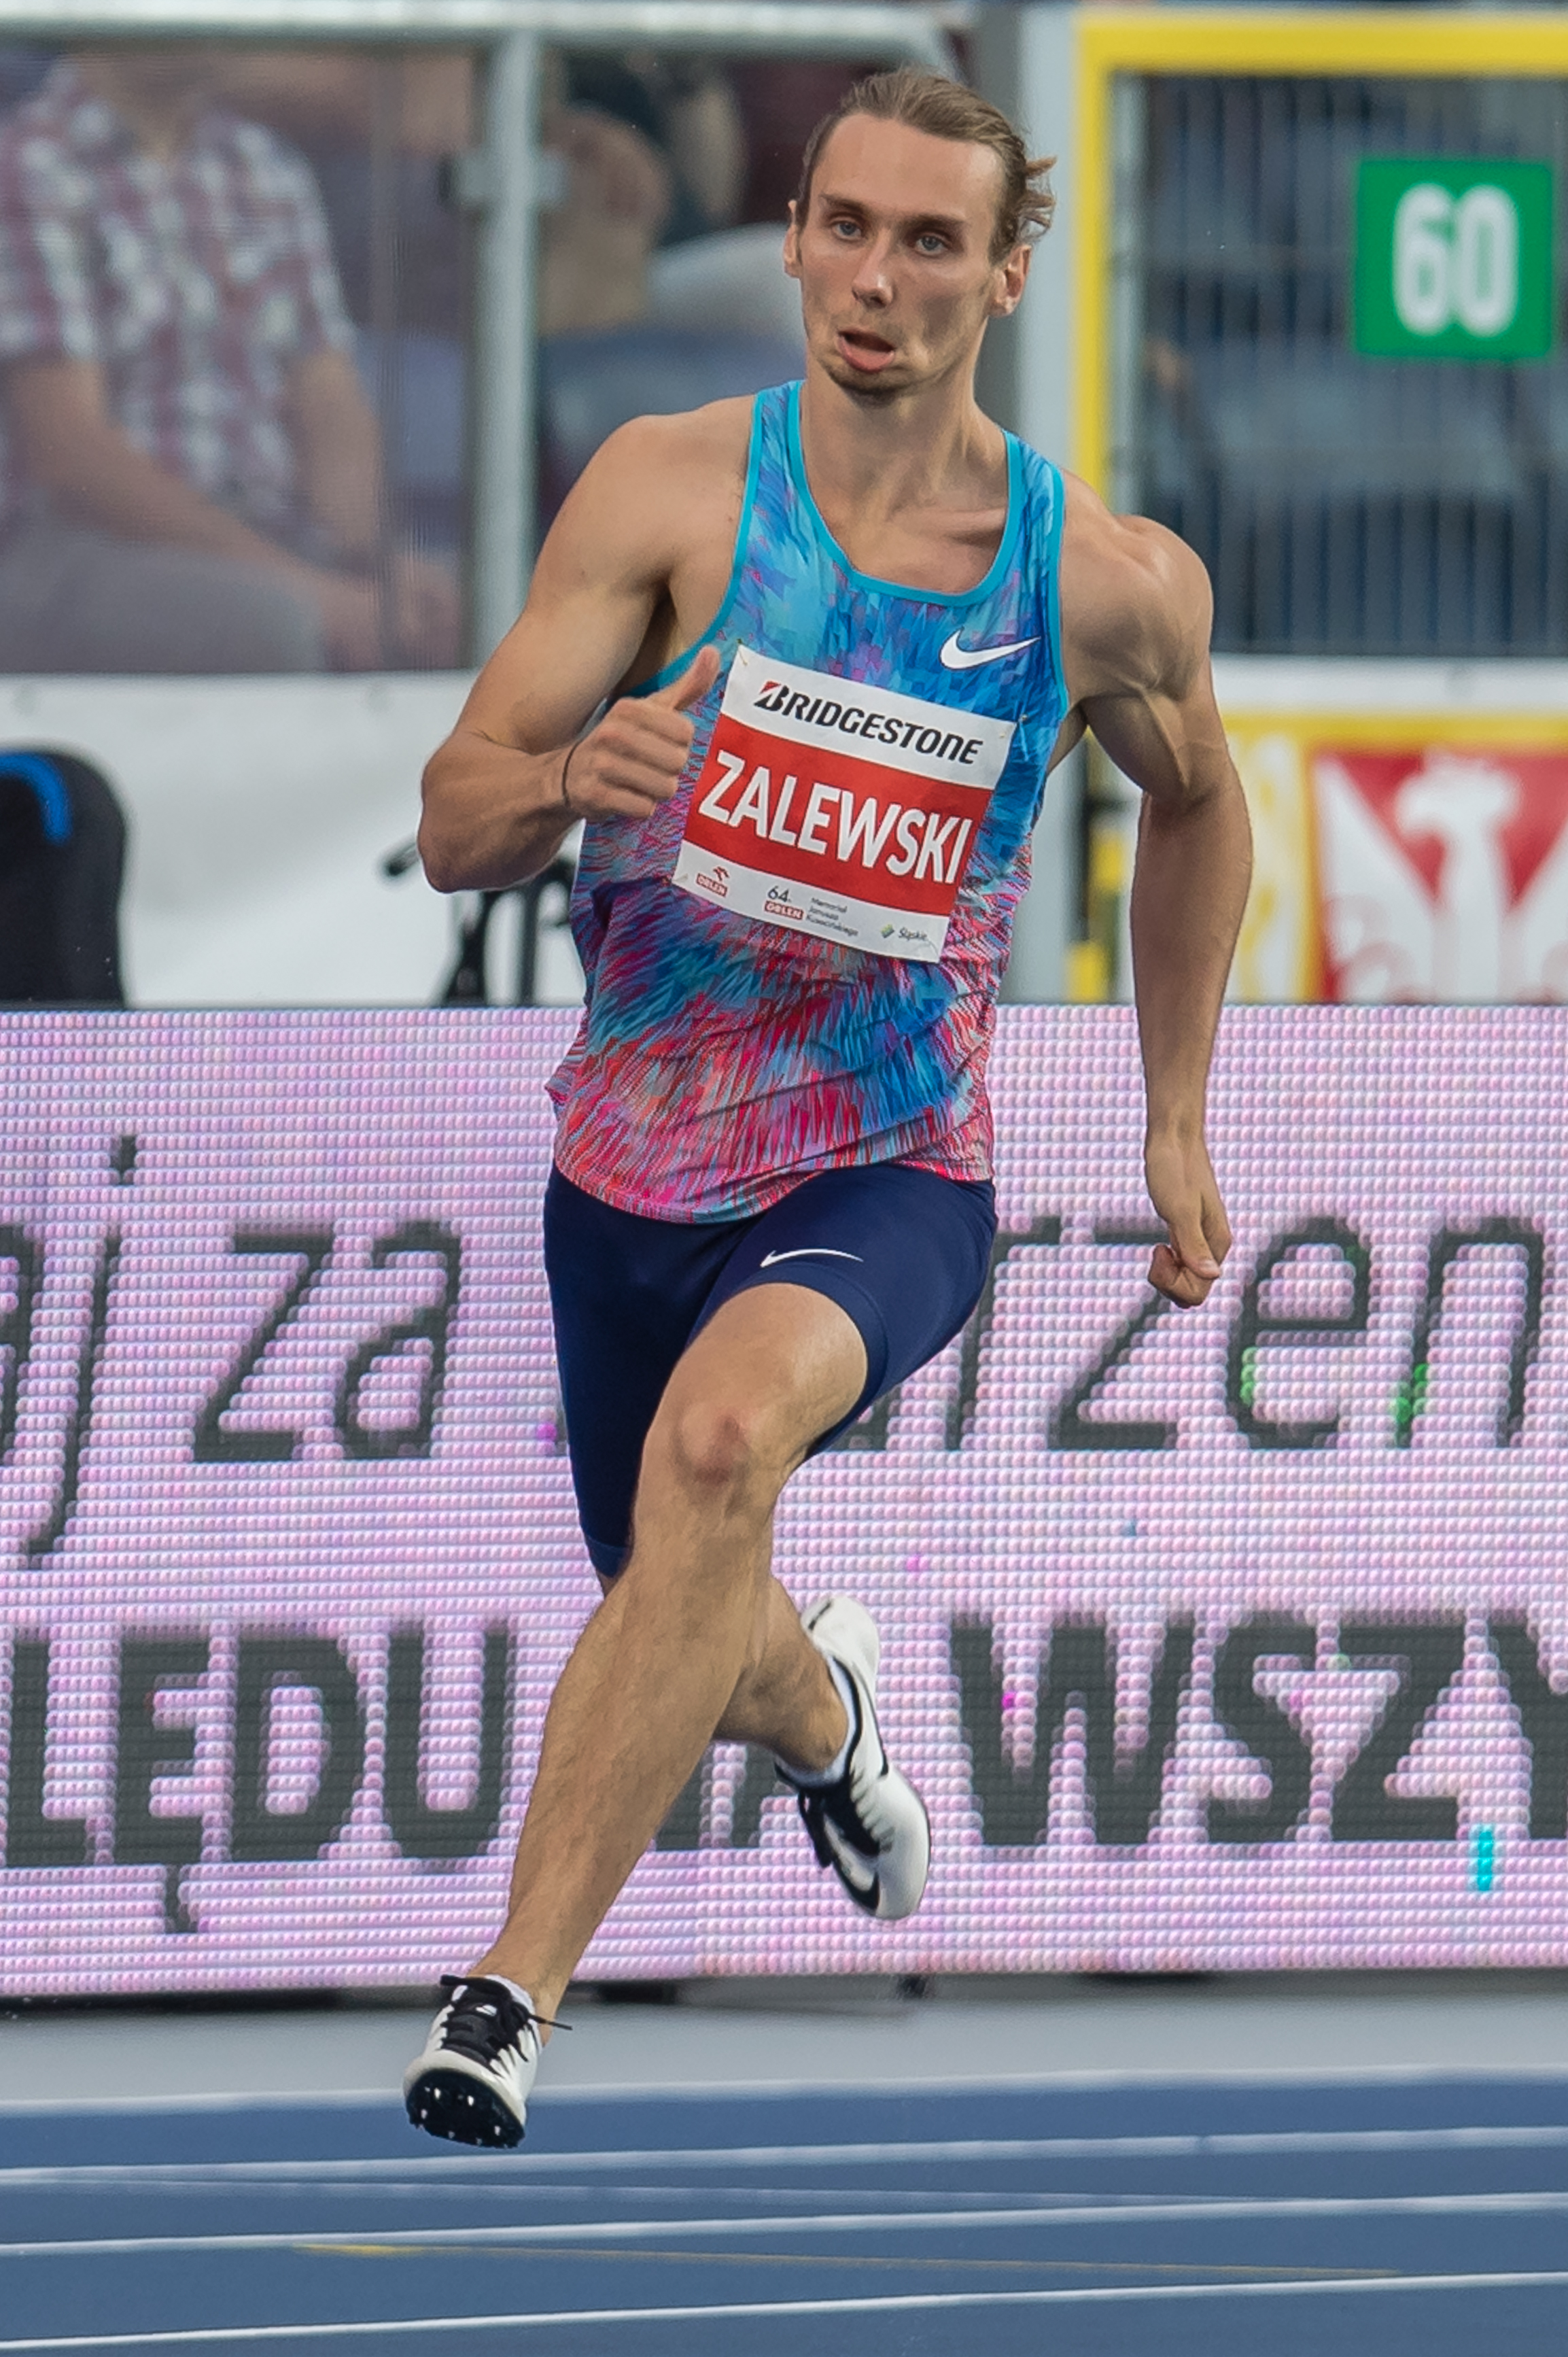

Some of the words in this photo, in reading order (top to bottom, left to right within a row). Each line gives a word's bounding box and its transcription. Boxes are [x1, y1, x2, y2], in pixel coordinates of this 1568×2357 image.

[1392, 182, 1520, 339] 60
[753, 681, 983, 765] BRIDGESTONE
[698, 749, 973, 884] ZALEWSKI
[765, 901, 804, 920] ORLEN
[193, 1218, 464, 1463] za
[557, 1214, 1544, 1451] rzen
